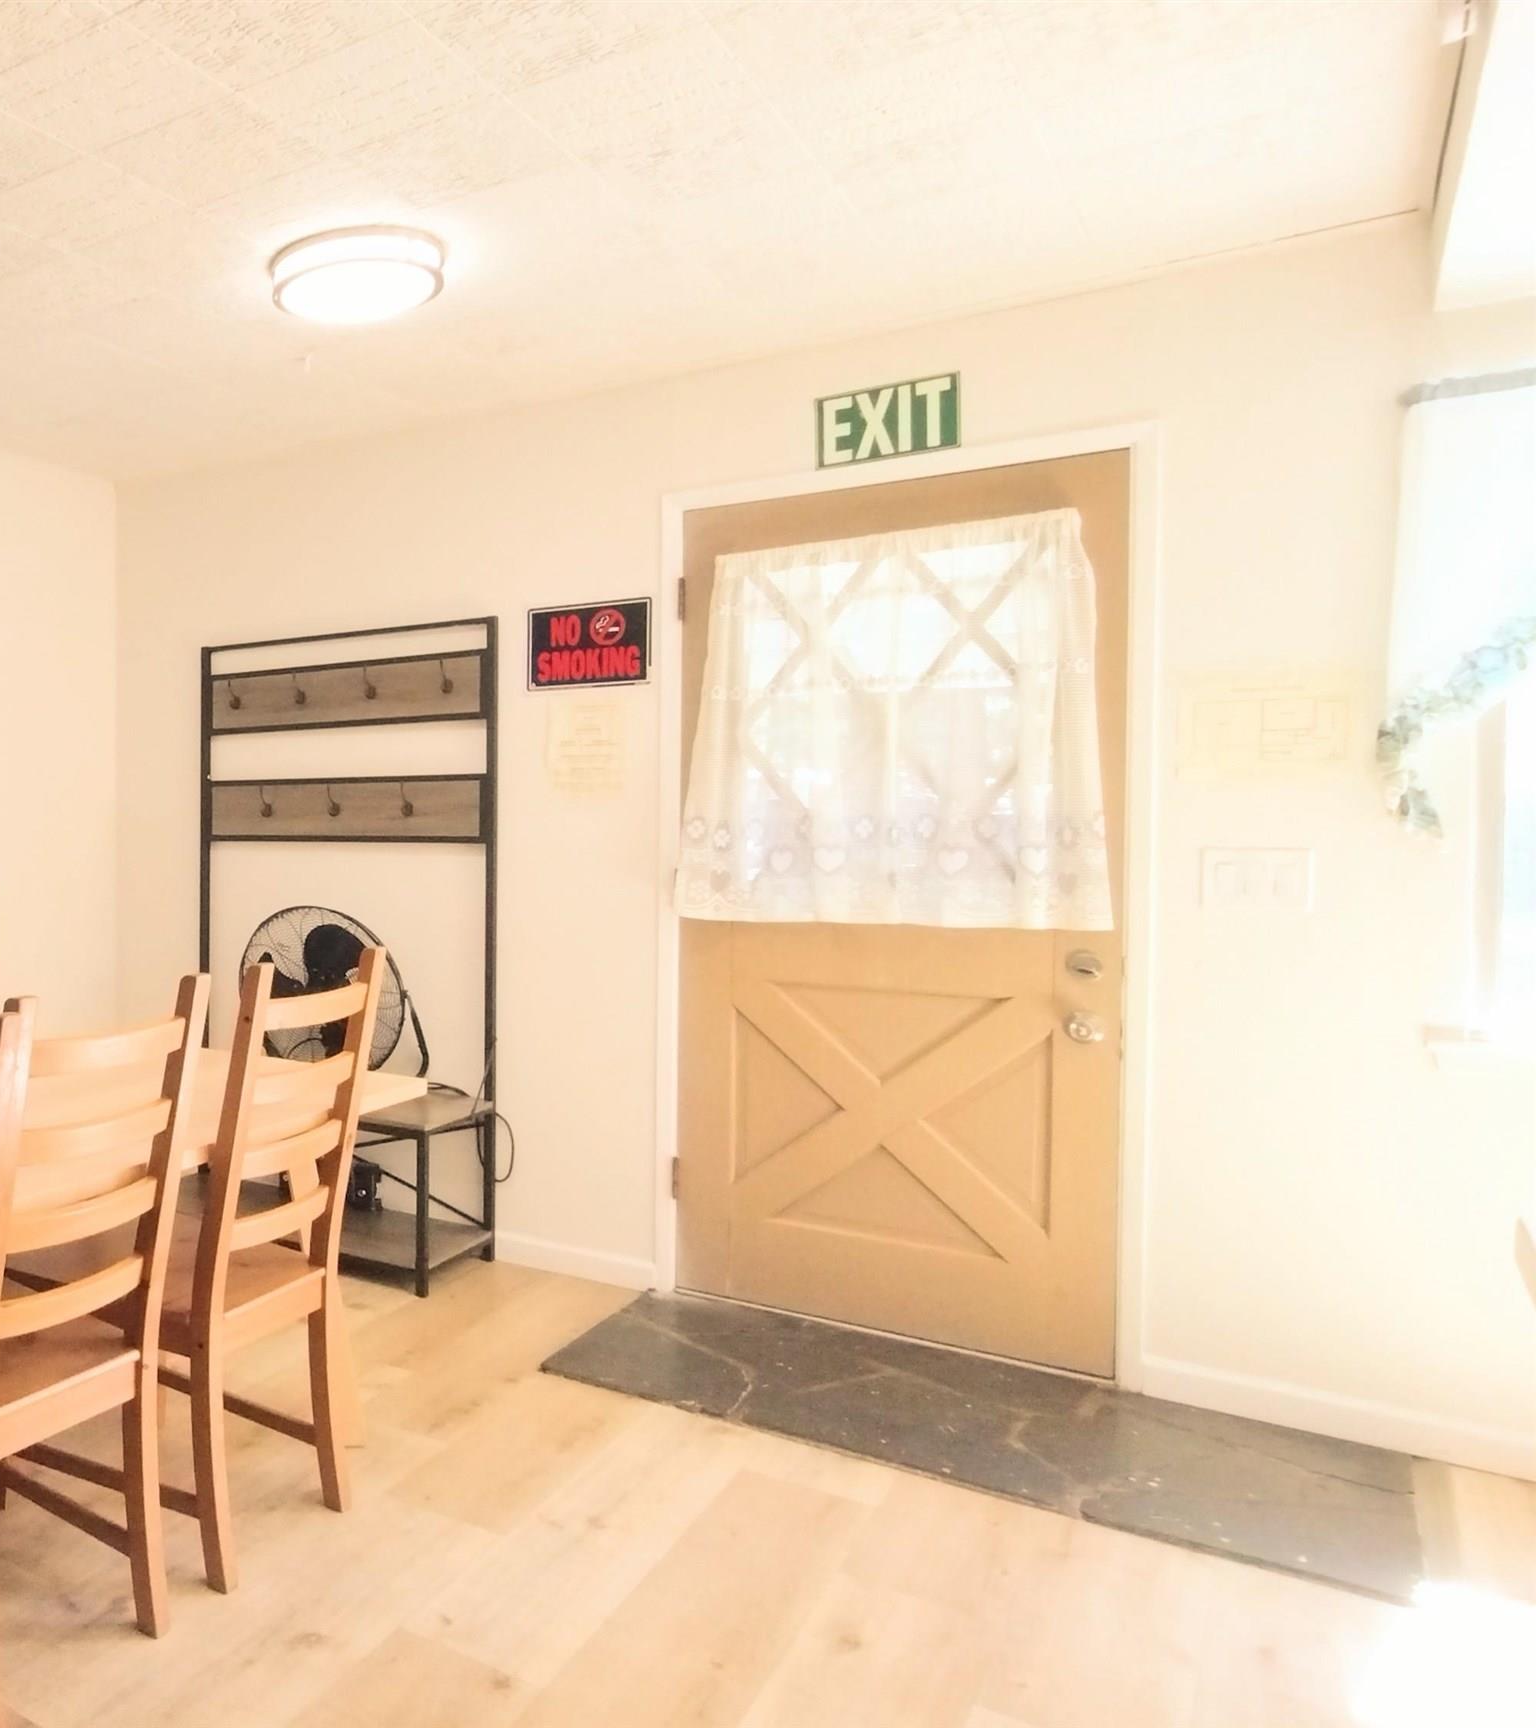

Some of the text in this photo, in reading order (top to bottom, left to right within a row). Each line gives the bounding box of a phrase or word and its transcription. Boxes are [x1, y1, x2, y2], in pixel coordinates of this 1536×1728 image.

[823, 376, 951, 466] EXIT
[550, 614, 581, 647] NO
[538, 645, 641, 683] SMOKING
